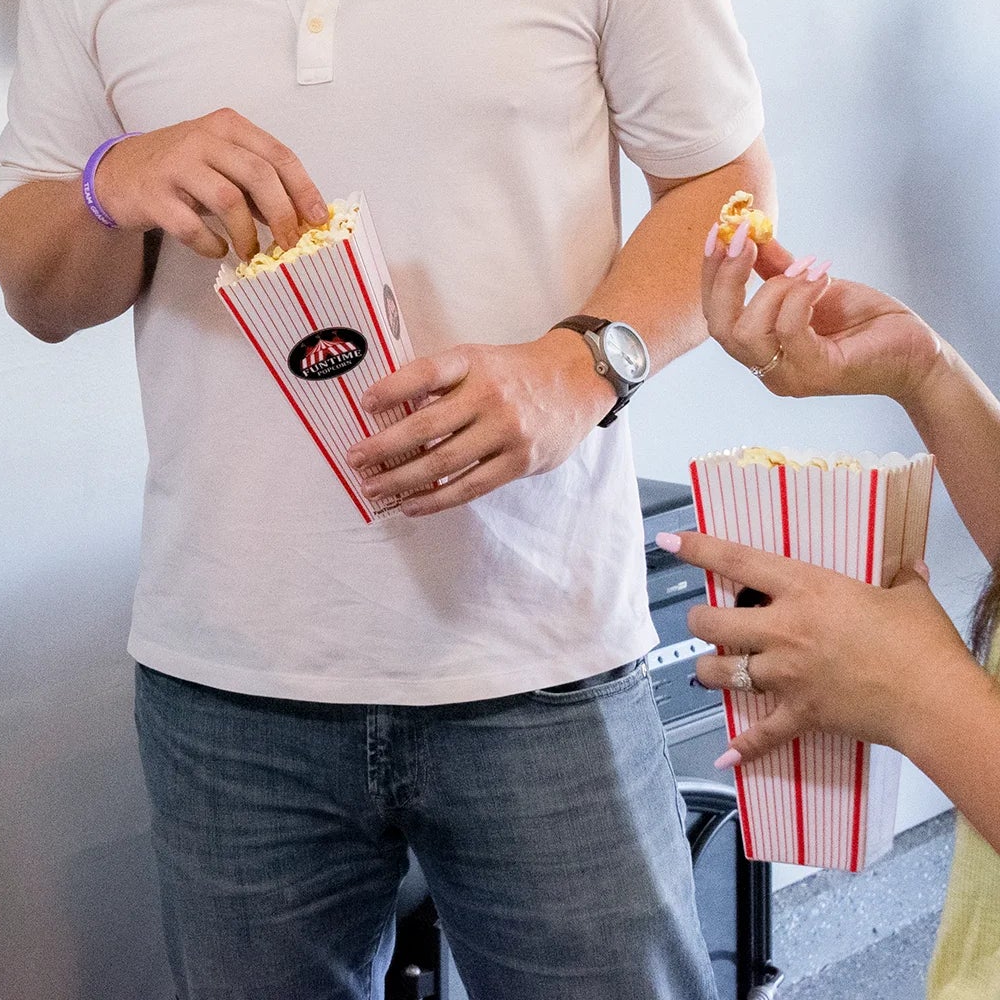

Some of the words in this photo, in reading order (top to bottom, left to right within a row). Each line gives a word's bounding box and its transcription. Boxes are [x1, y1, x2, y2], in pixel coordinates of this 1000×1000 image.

[84, 181, 93, 204] TEAM
[302, 349, 362, 377] FUNTIME
[317, 360, 352, 376] POPCORN
